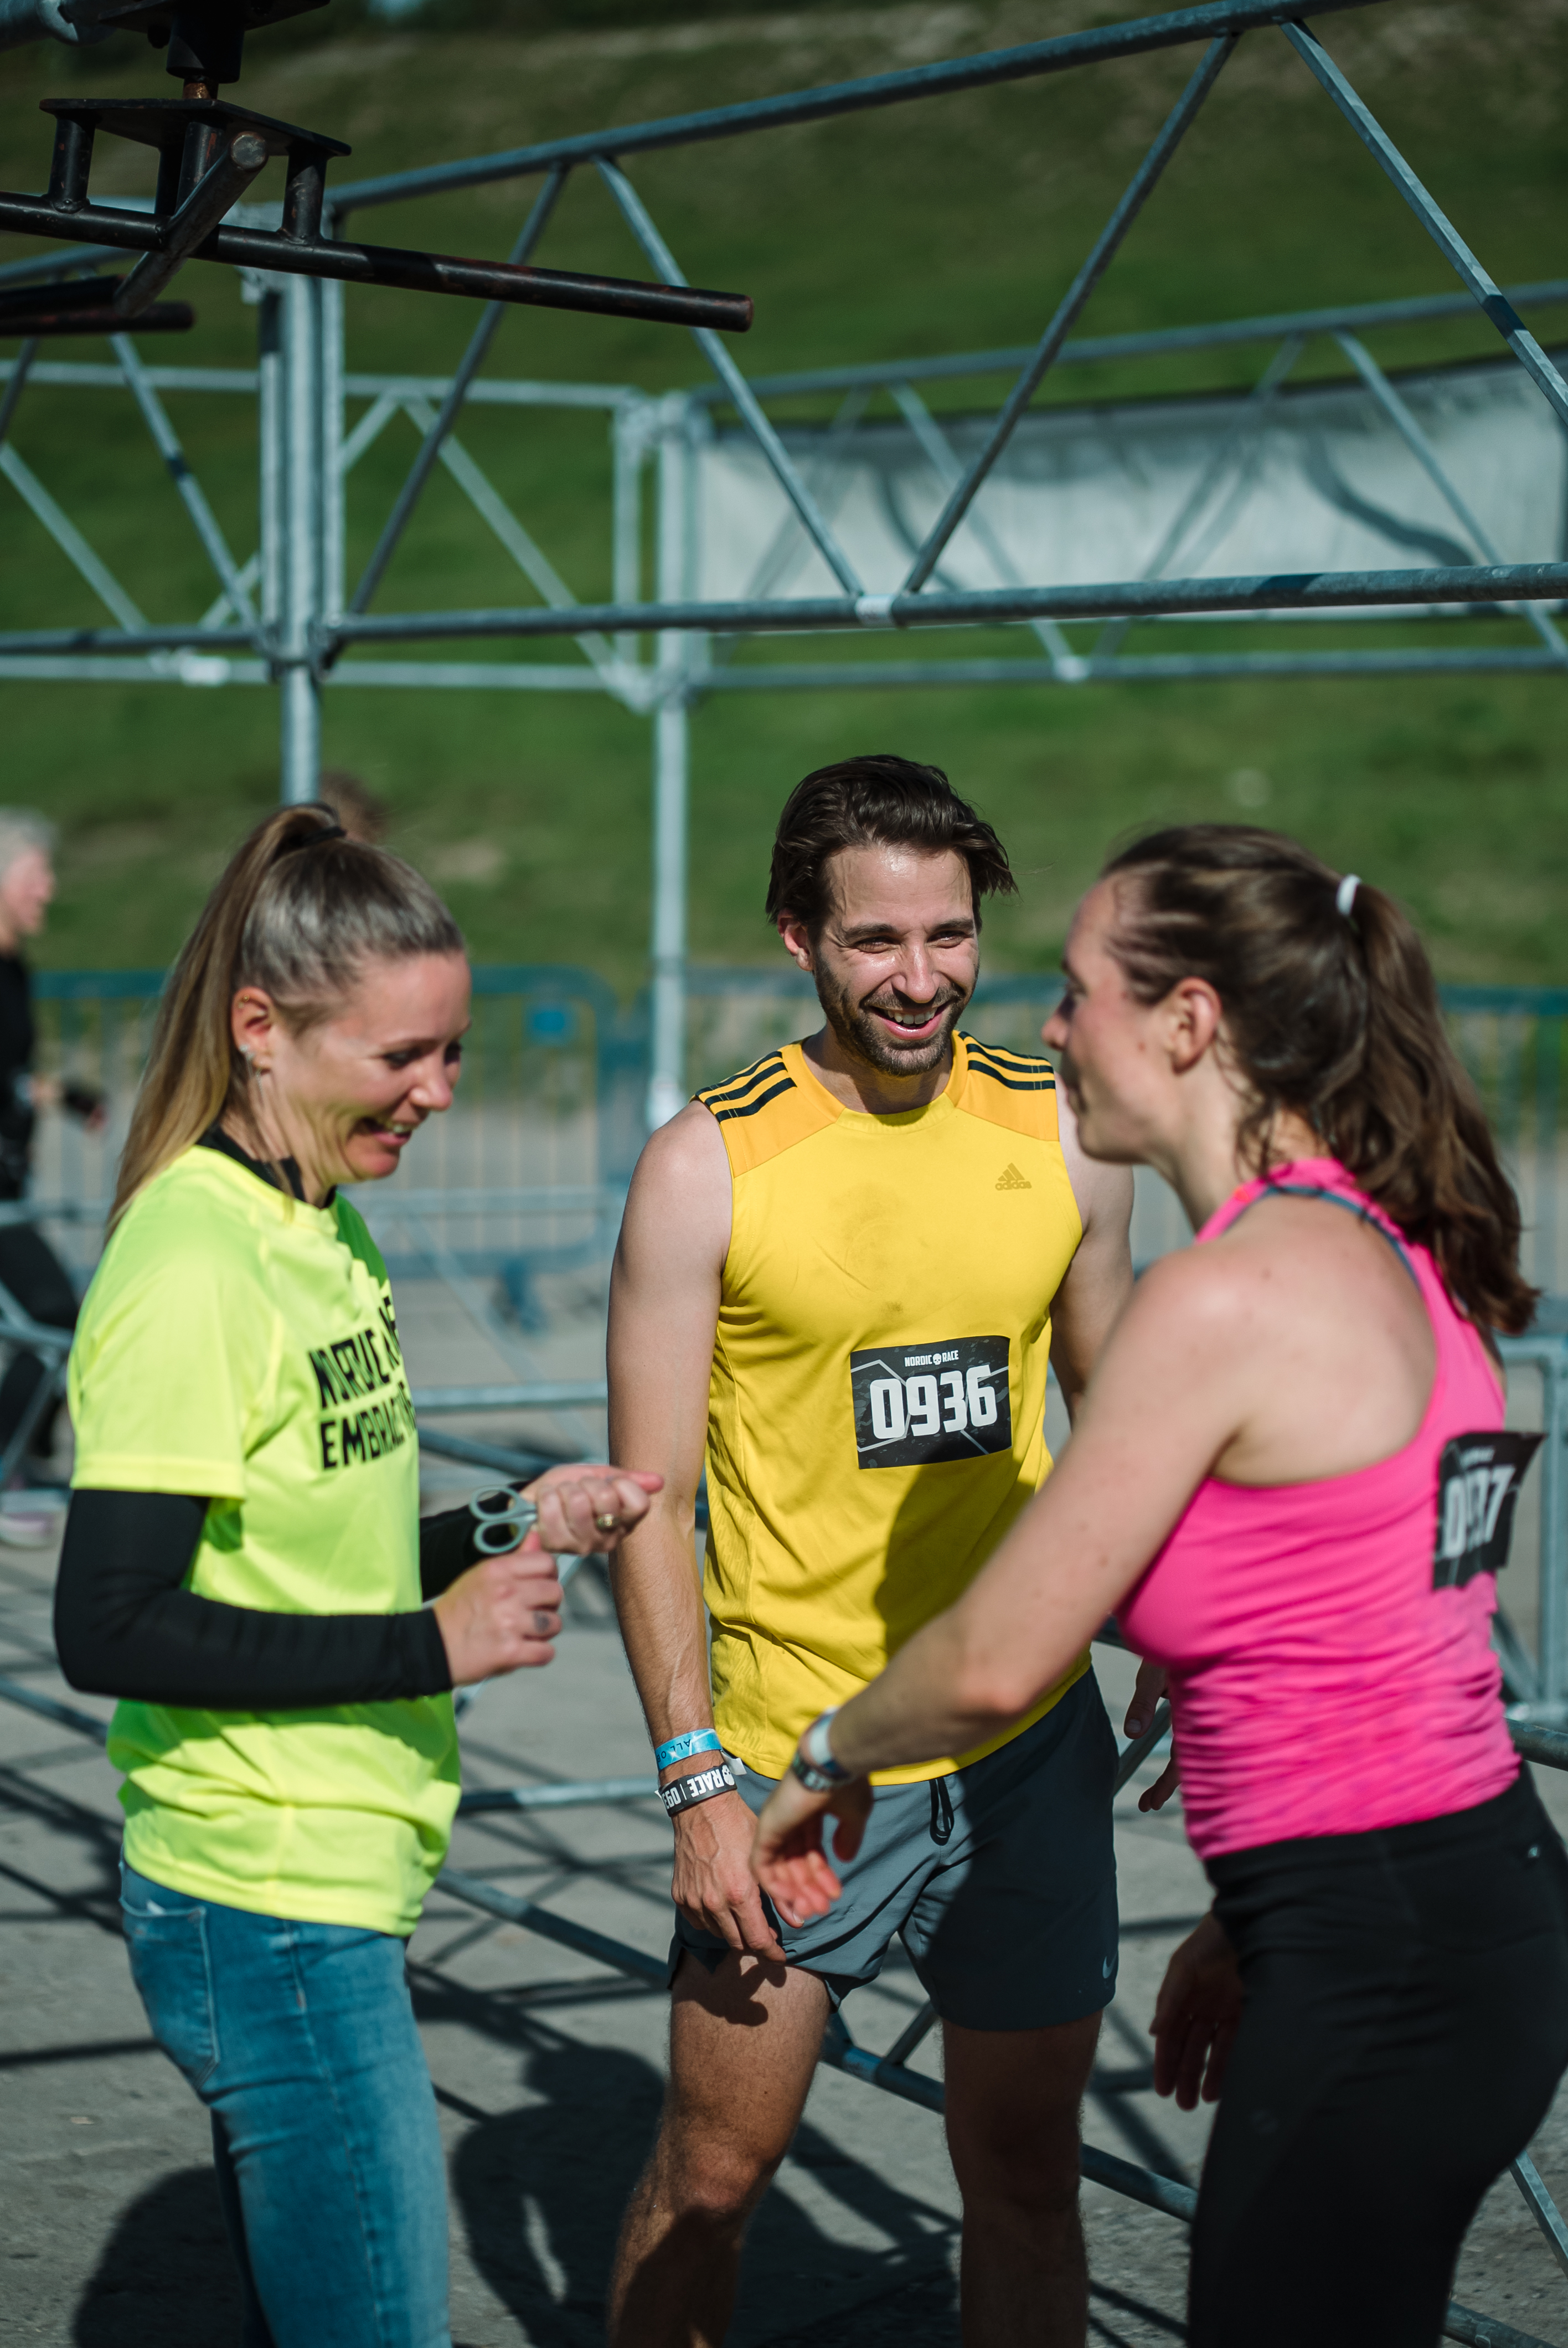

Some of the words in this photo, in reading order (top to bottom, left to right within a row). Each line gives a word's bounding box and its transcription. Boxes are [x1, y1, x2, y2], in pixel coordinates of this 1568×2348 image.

[995, 1180, 1032, 1191] adidas
[904, 1354, 933, 1367] NORDIC
[942, 1350, 959, 1363] RACE
[869, 1364, 998, 1439] 0936
[670, 1738, 691, 1752] ALL
[687, 1768, 725, 1798] RACE
